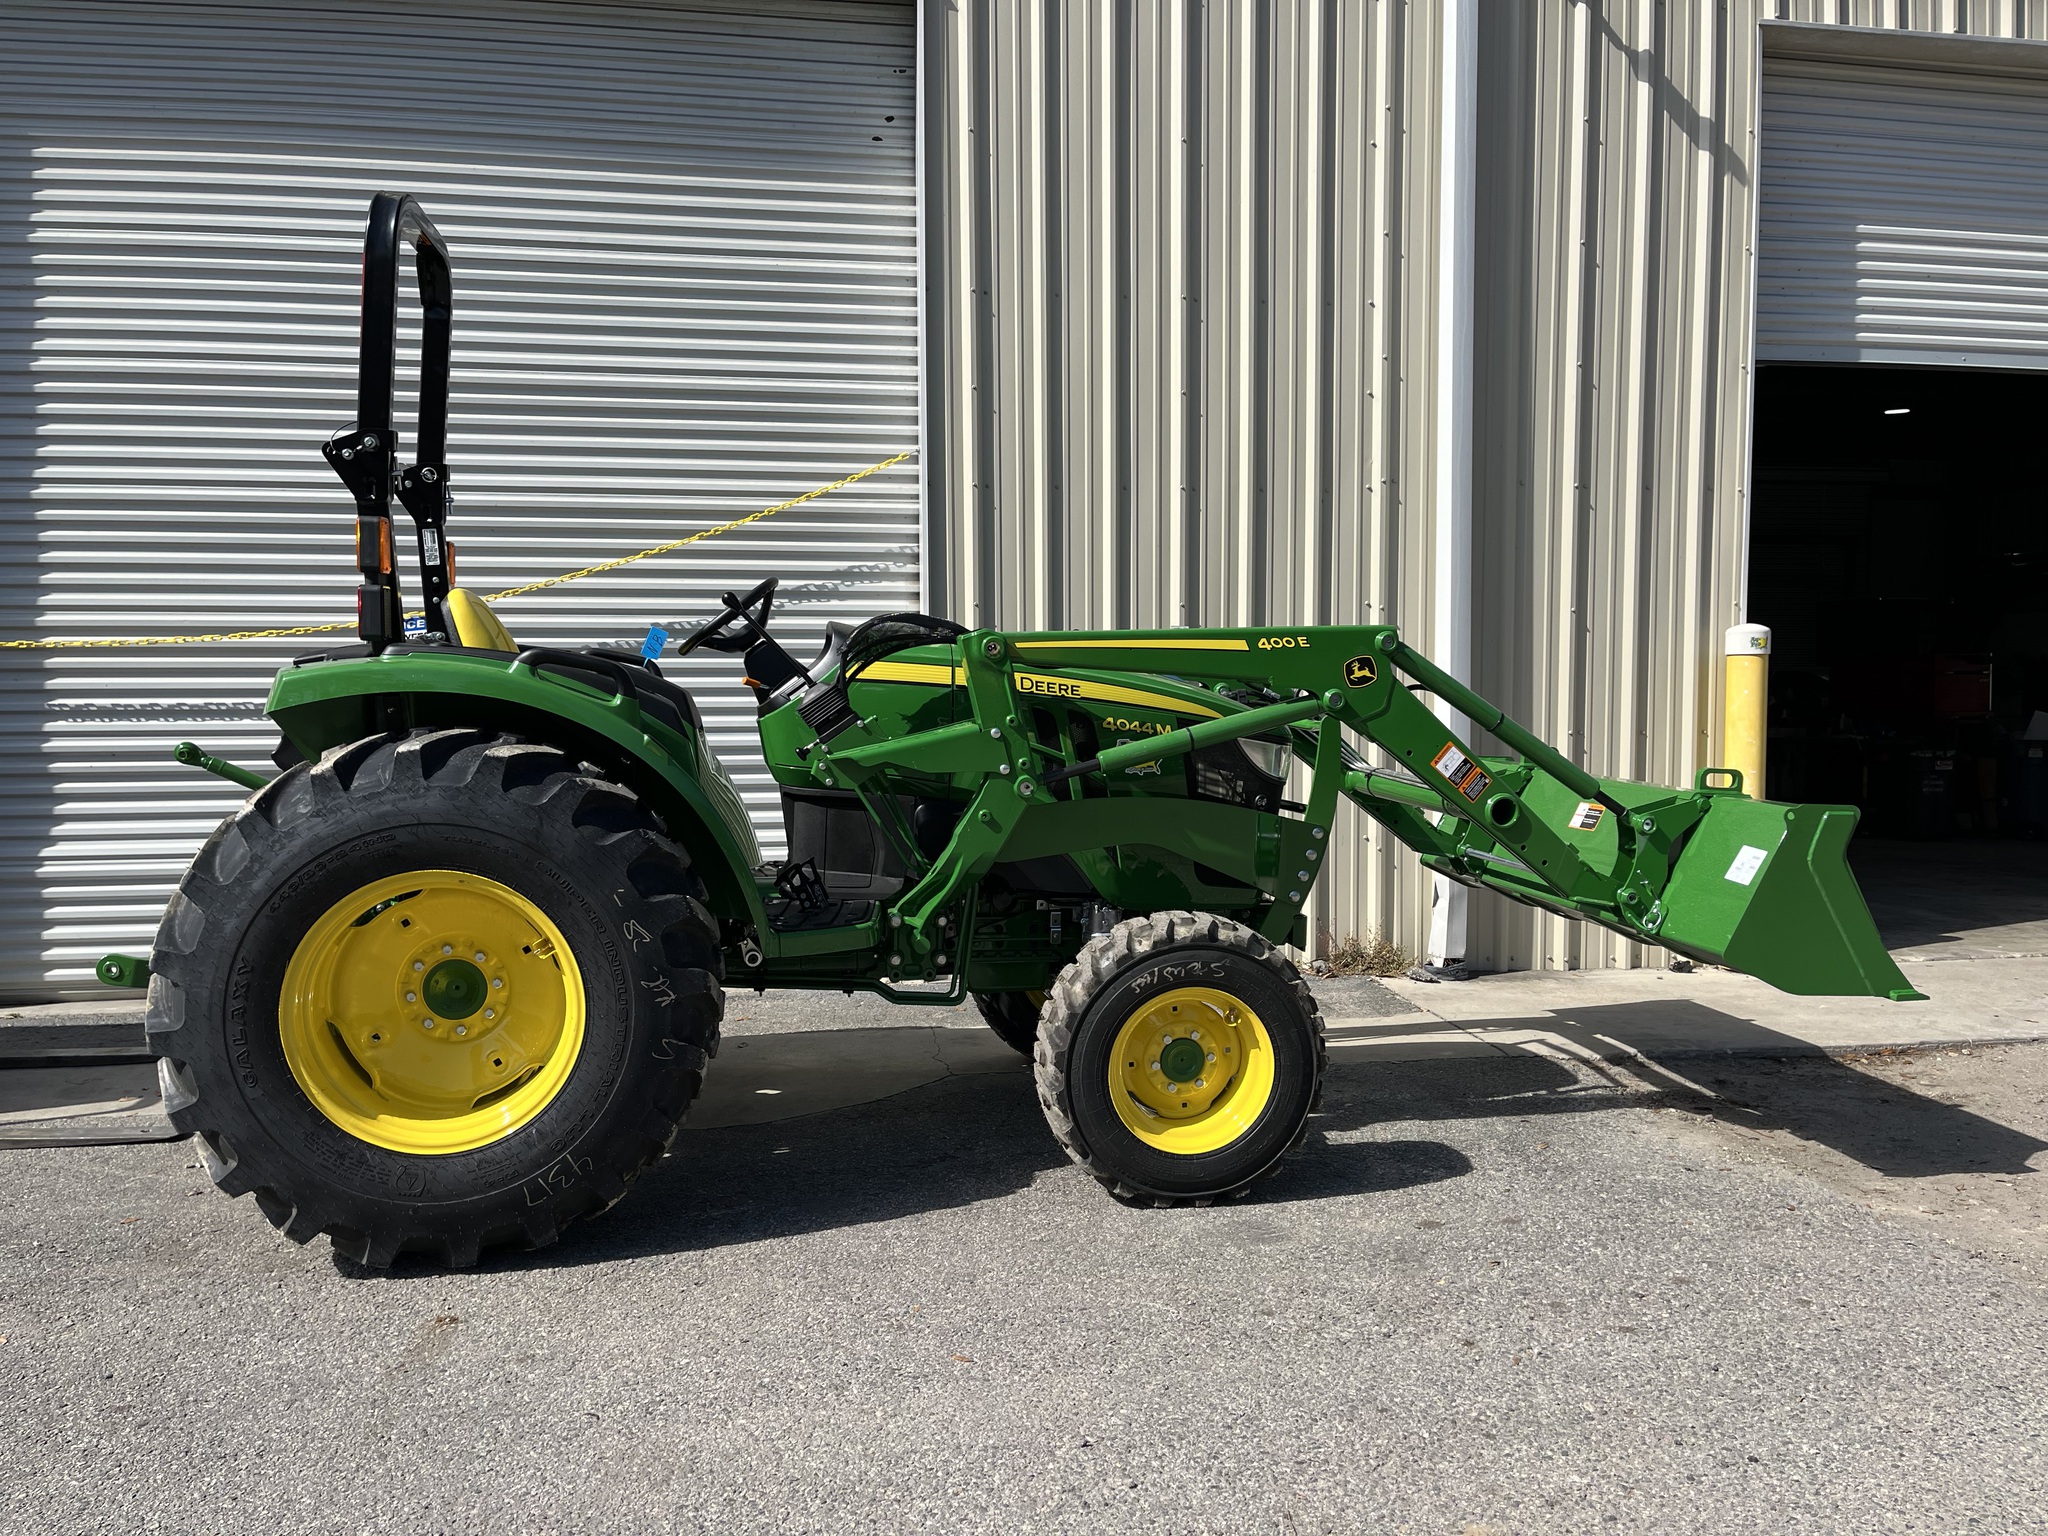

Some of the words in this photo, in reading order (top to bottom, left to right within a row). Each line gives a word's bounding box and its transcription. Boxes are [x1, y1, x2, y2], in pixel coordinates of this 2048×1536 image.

[1020, 676, 1081, 697] DEERE
[535, 860, 606, 935] SUPER
[231, 955, 259, 1088] GALAXY
[594, 939, 629, 1103] INDUSTRIAL
[551, 1109, 595, 1151] LUG
